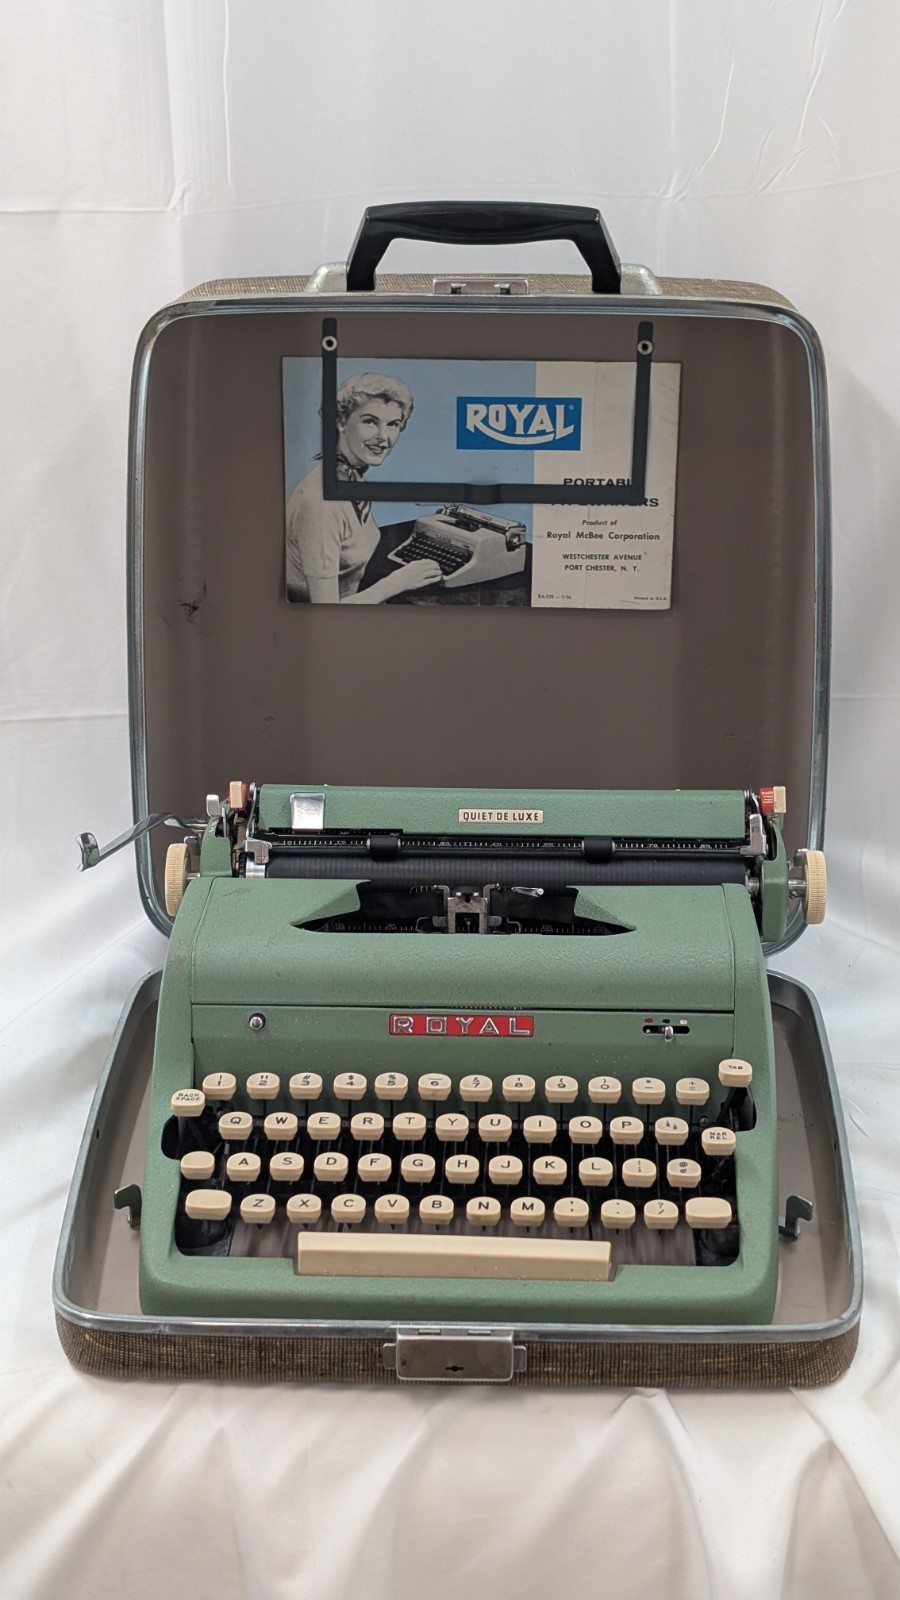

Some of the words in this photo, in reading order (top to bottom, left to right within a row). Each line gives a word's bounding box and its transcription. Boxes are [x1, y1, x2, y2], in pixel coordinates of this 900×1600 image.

[466, 403, 575, 445] ROYAL
[546, 531, 571, 541] Royal
[608, 532, 660, 541] Corporation
[463, 811, 493, 821] QUIET
[496, 812, 509, 820] DE
[513, 812, 539, 821] LUXE
[393, 1016, 530, 1034] ROYAL
[230, 1116, 242, 1125] Q
[275, 1116, 288, 1125] W
[318, 1116, 330, 1125] E
[362, 1117, 374, 1125] R
[405, 1117, 415, 1125] T
[448, 1118, 458, 1126] Y
[490, 1118, 502, 1127] U
[579, 1120, 592, 1129] O
[621, 1121, 632, 1129] P
[238, 1157, 250, 1166] A
[282, 1157, 293, 1166] S
[325, 1157, 338, 1166] D
[369, 1157, 381, 1166] F
[412, 1159, 425, 1167] G
[457, 1159, 468, 1168] H
[500, 1160, 511, 1169] J
[545, 1160, 556, 1169] K
[591, 1162, 602, 1170] L
[252, 1198, 264, 1207] Z
[298, 1198, 310, 1208] X
[343, 1199, 354, 1208] C
[387, 1199, 398, 1208] V
[431, 1200, 442, 1209] B
[477, 1201, 489, 1210] N
[522, 1202, 534, 1211] M
